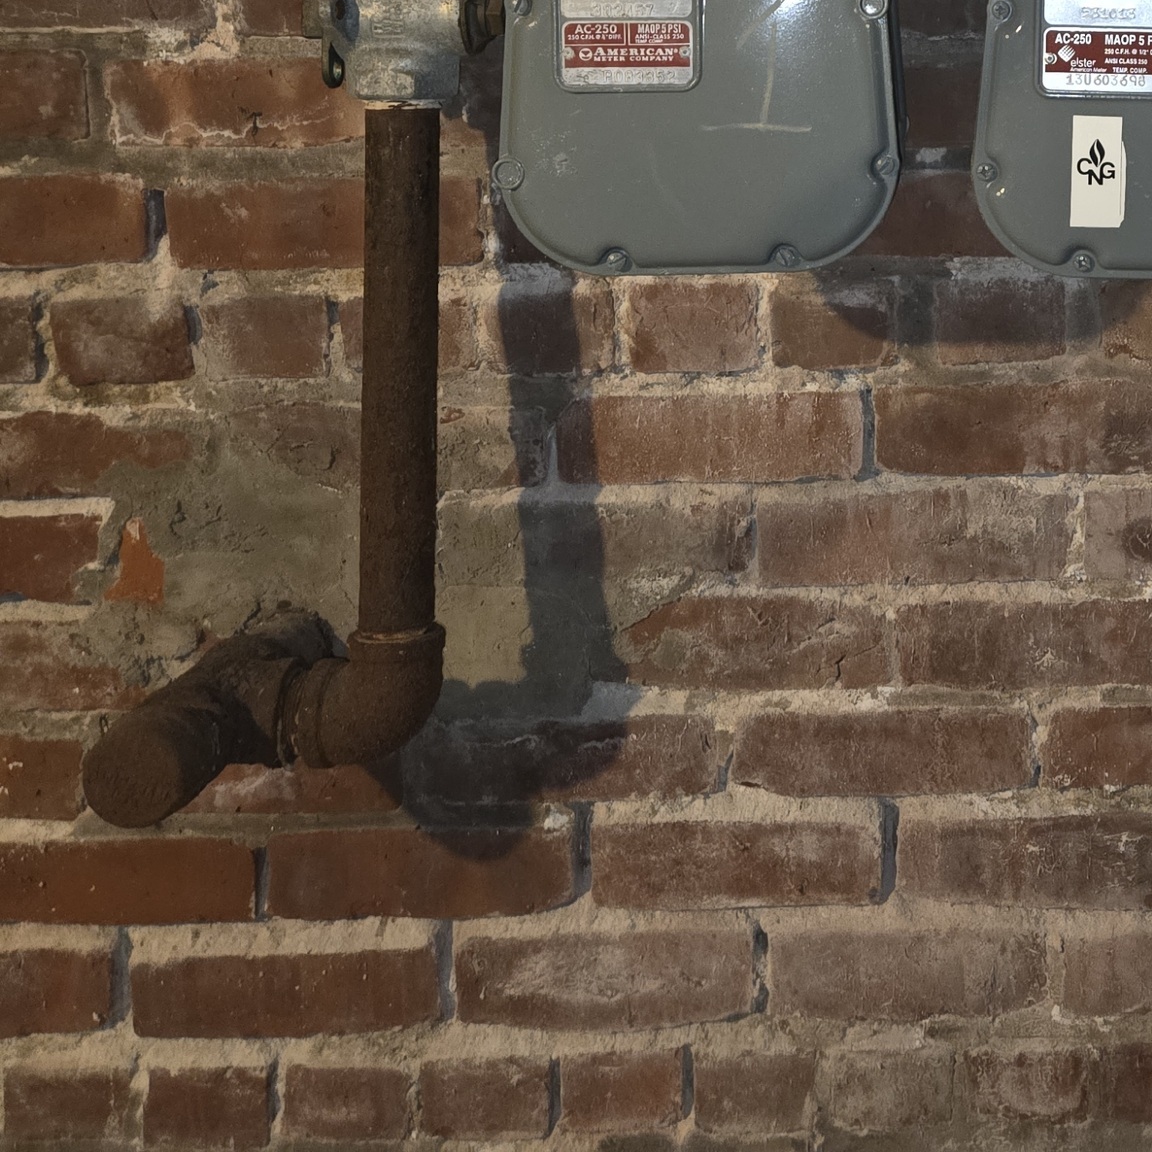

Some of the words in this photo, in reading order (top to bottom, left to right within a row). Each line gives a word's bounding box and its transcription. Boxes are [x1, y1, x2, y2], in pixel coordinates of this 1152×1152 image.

[575, 24, 617, 34] AC-250
[638, 24, 660, 33] MAOP
[661, 24, 666, 33] 5
[668, 24, 681, 33] PSI
[1104, 34, 1136, 45] MAOP
[1138, 35, 1145, 46] 5
[1070, 57, 1096, 67] elster
[1077, 158, 1115, 185] CNG
